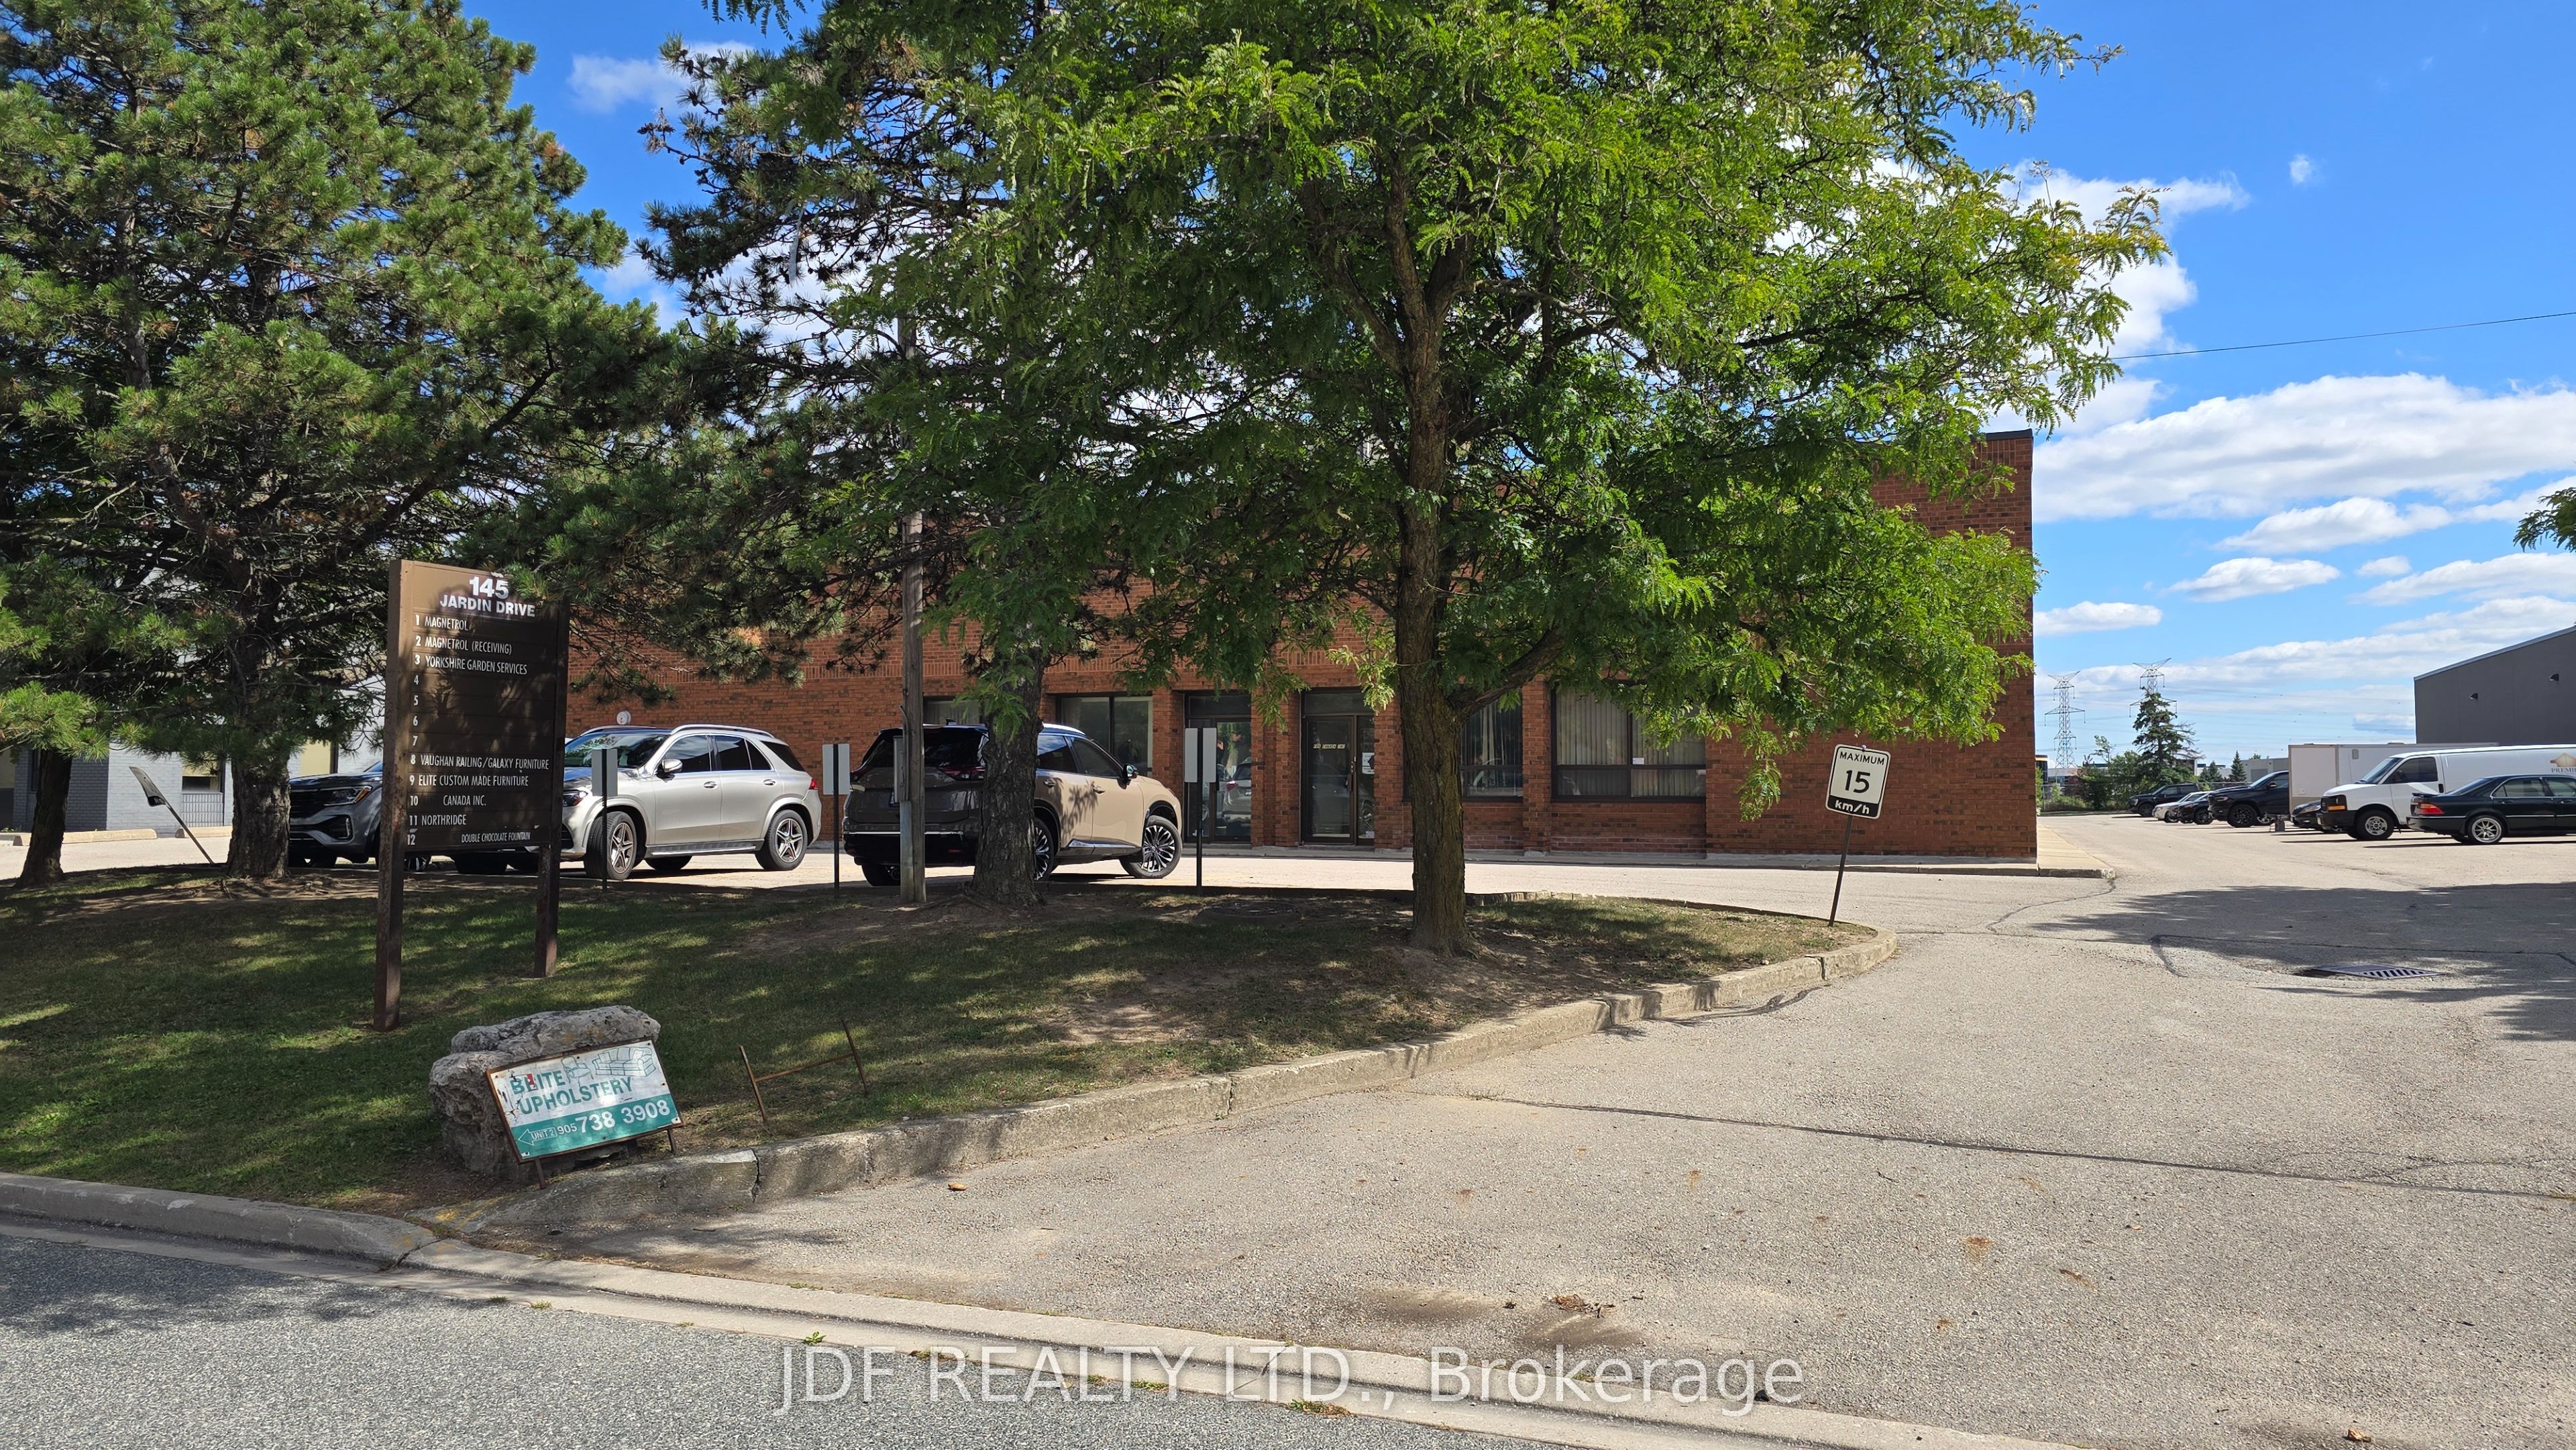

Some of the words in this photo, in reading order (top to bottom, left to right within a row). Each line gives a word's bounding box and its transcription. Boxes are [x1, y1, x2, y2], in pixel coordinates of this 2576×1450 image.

[470, 576, 509, 599] 145
[439, 594, 492, 612] JARDIN
[496, 602, 535, 617] DRIVE
[415, 614, 420, 625] 1
[425, 615, 468, 631] MAGNETROL
[416, 635, 421, 647] 2
[425, 636, 468, 651] MAGNETROL
[472, 641, 512, 656] (RECEIVING)
[415, 654, 421, 665] 3
[425, 655, 466, 670] YORKSHIRE
[467, 659, 495, 672] GARDEN
[496, 662, 527, 675] SERVICES
[414, 675, 419, 685] 4
[413, 695, 419, 706] 5
[413, 716, 419, 726] 6
[413, 735, 418, 746] 7
[411, 754, 416, 765] 8
[421, 754, 454, 767] VAUGHAN
[515, 758, 549, 770] FURNITURE
[1839, 752, 1884, 765] MAXIMUM
[409, 776, 415, 786] 9
[419, 775, 437, 786] ELITE
[439, 775, 470, 786] CUSTOM
[471, 776, 491, 786] MADE
[493, 776, 529, 786] FURNITURE
[1845, 770, 1870, 793] 15
[410, 795, 419, 806] 10
[443, 795, 470, 806] CANADA
[473, 795, 486, 806] INC.
[1835, 800, 1870, 815] km/h
[409, 815, 417, 826] 11
[421, 814, 466, 826] NORTHRIDGE
[407, 834, 415, 845] 12
[462, 834, 480, 843] DOUBLE
[481, 833, 507, 842] CHOCOLATE
[508, 832, 531, 841] FOUNTAIN
[520, 1076, 632, 1115] UPHOLSTERY
[531, 1130, 548, 1140] UNIT
[557, 1123, 577, 1135] 905
[575, 1111, 615, 1133] 738
[621, 1099, 670, 1124] 3908
